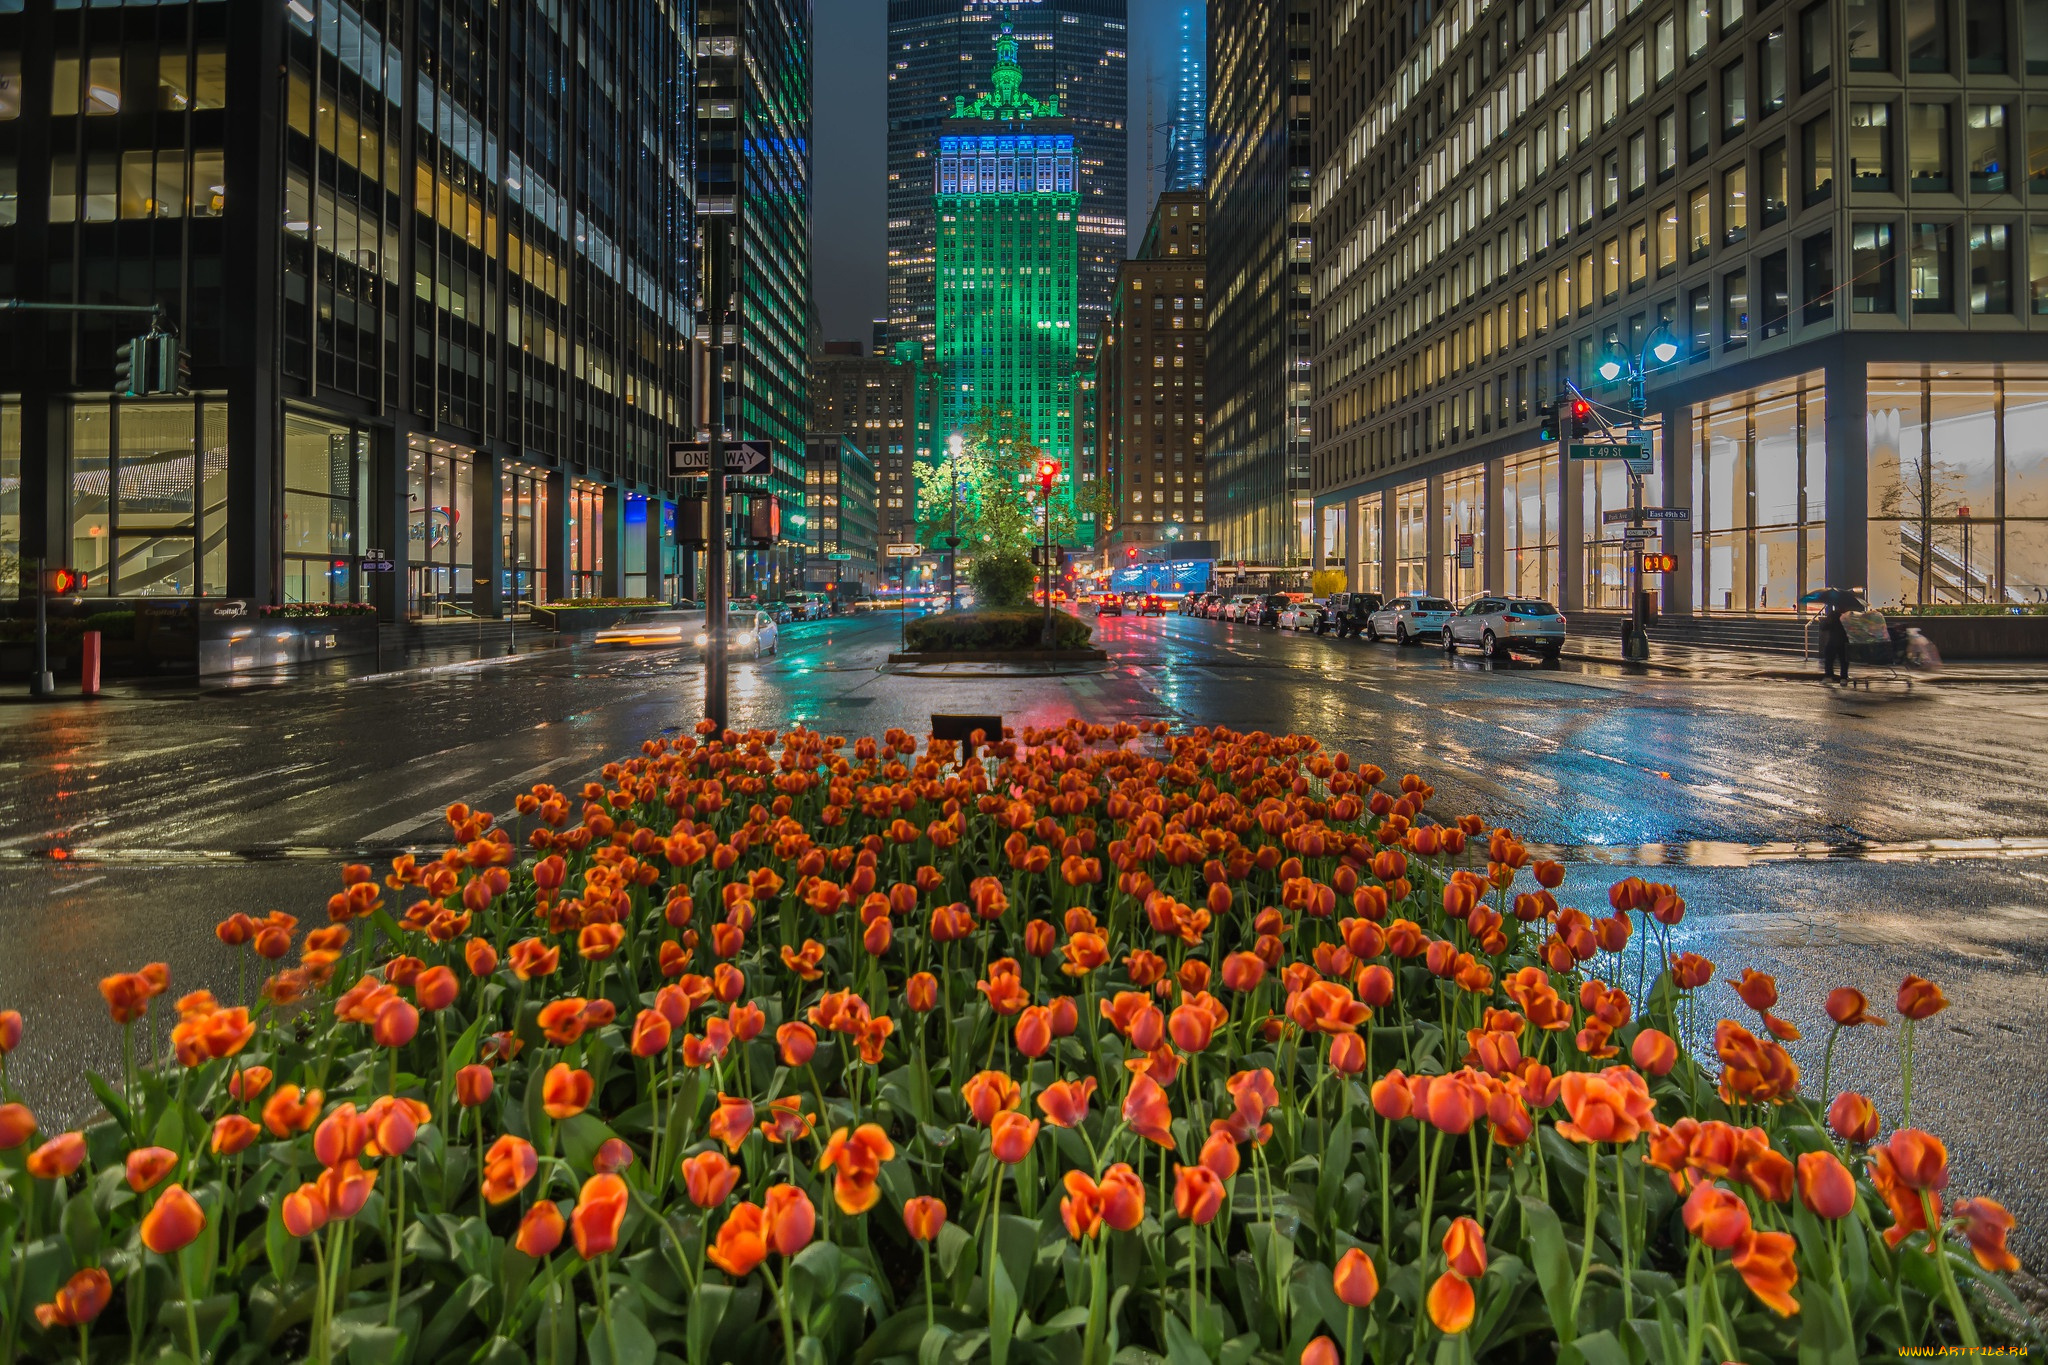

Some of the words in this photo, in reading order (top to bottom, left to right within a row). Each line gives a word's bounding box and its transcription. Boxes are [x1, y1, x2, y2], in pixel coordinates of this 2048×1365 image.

[1589, 447, 1594, 457] E
[1598, 447, 1609, 457] 49
[1612, 447, 1622, 457] St
[1641, 448, 1651, 460] 5
[683, 452, 709, 466] ONE
[725, 452, 756, 465] WAY
[1649, 510, 1664, 518] East
[1664, 509, 1679, 518] 49th
